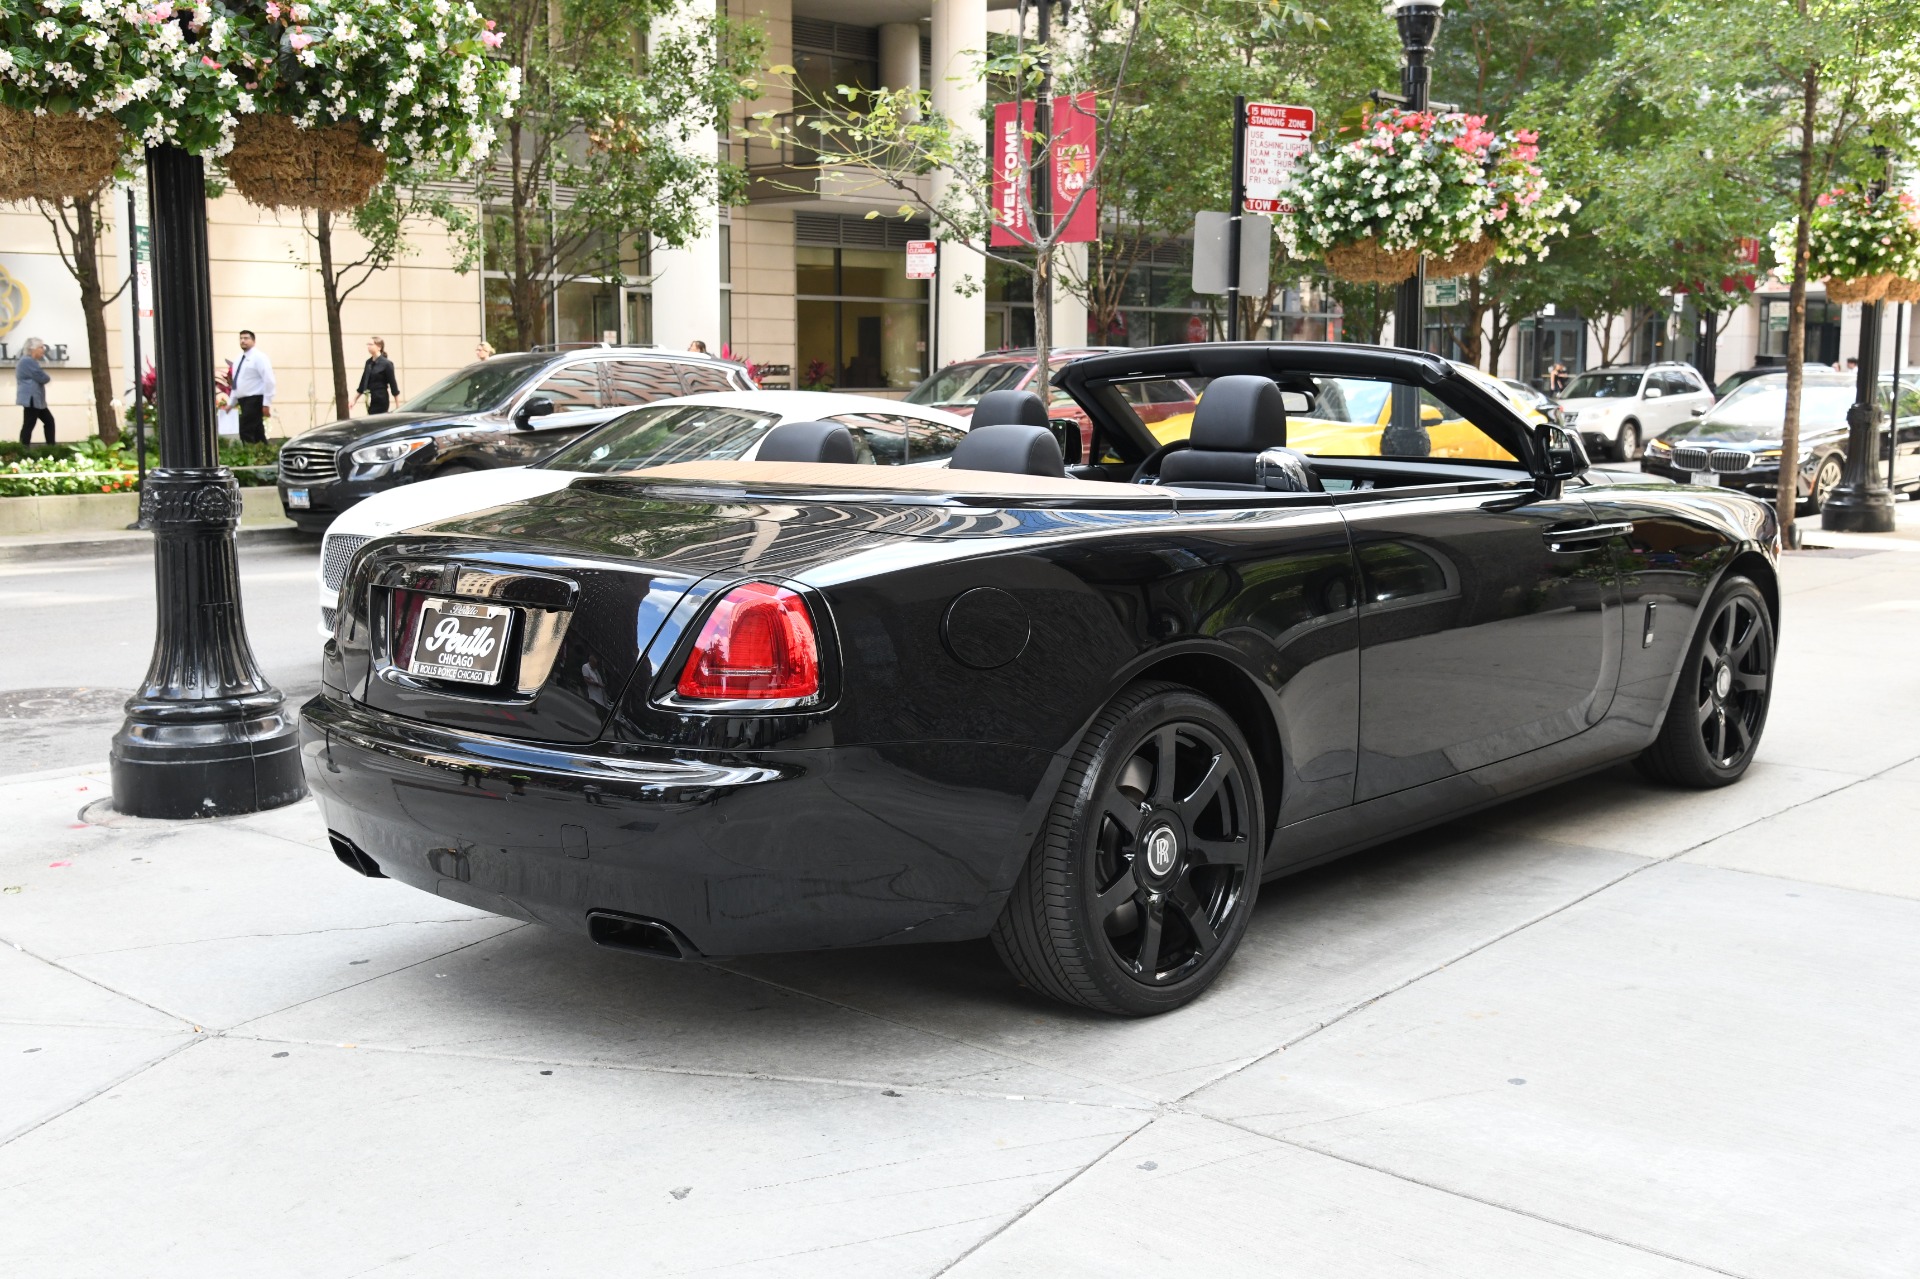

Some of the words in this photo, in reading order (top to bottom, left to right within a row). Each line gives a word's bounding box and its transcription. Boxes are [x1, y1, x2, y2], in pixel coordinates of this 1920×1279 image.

[1251, 106, 1259, 115] 15
[1261, 108, 1287, 118] MINUTE
[1251, 116, 1285, 127] STANDING
[1288, 119, 1306, 129] ZONE
[1250, 131, 1264, 139] USE
[1250, 140, 1284, 150] FLASHING
[1286, 143, 1309, 152] LIGHTS
[1259, 149, 1270, 157] AM
[1277, 150, 1281, 158] 8
[1284, 151, 1294, 159] PM
[1249, 158, 1265, 166] MON
[1274, 159, 1297, 169] THURS
[1003, 121, 1018, 227] WELCOME
[1249, 176, 1261, 184] FRI
[1248, 199, 1272, 211] TOW
[450, 604, 479, 615] Perillo
[425, 617, 496, 658] Perillo
[438, 653, 473, 668] CHICAGO
[419, 664, 437, 675] ROLLS
[437, 666, 457, 678] ROYCE
[457, 670, 483, 681] CHICAGO
